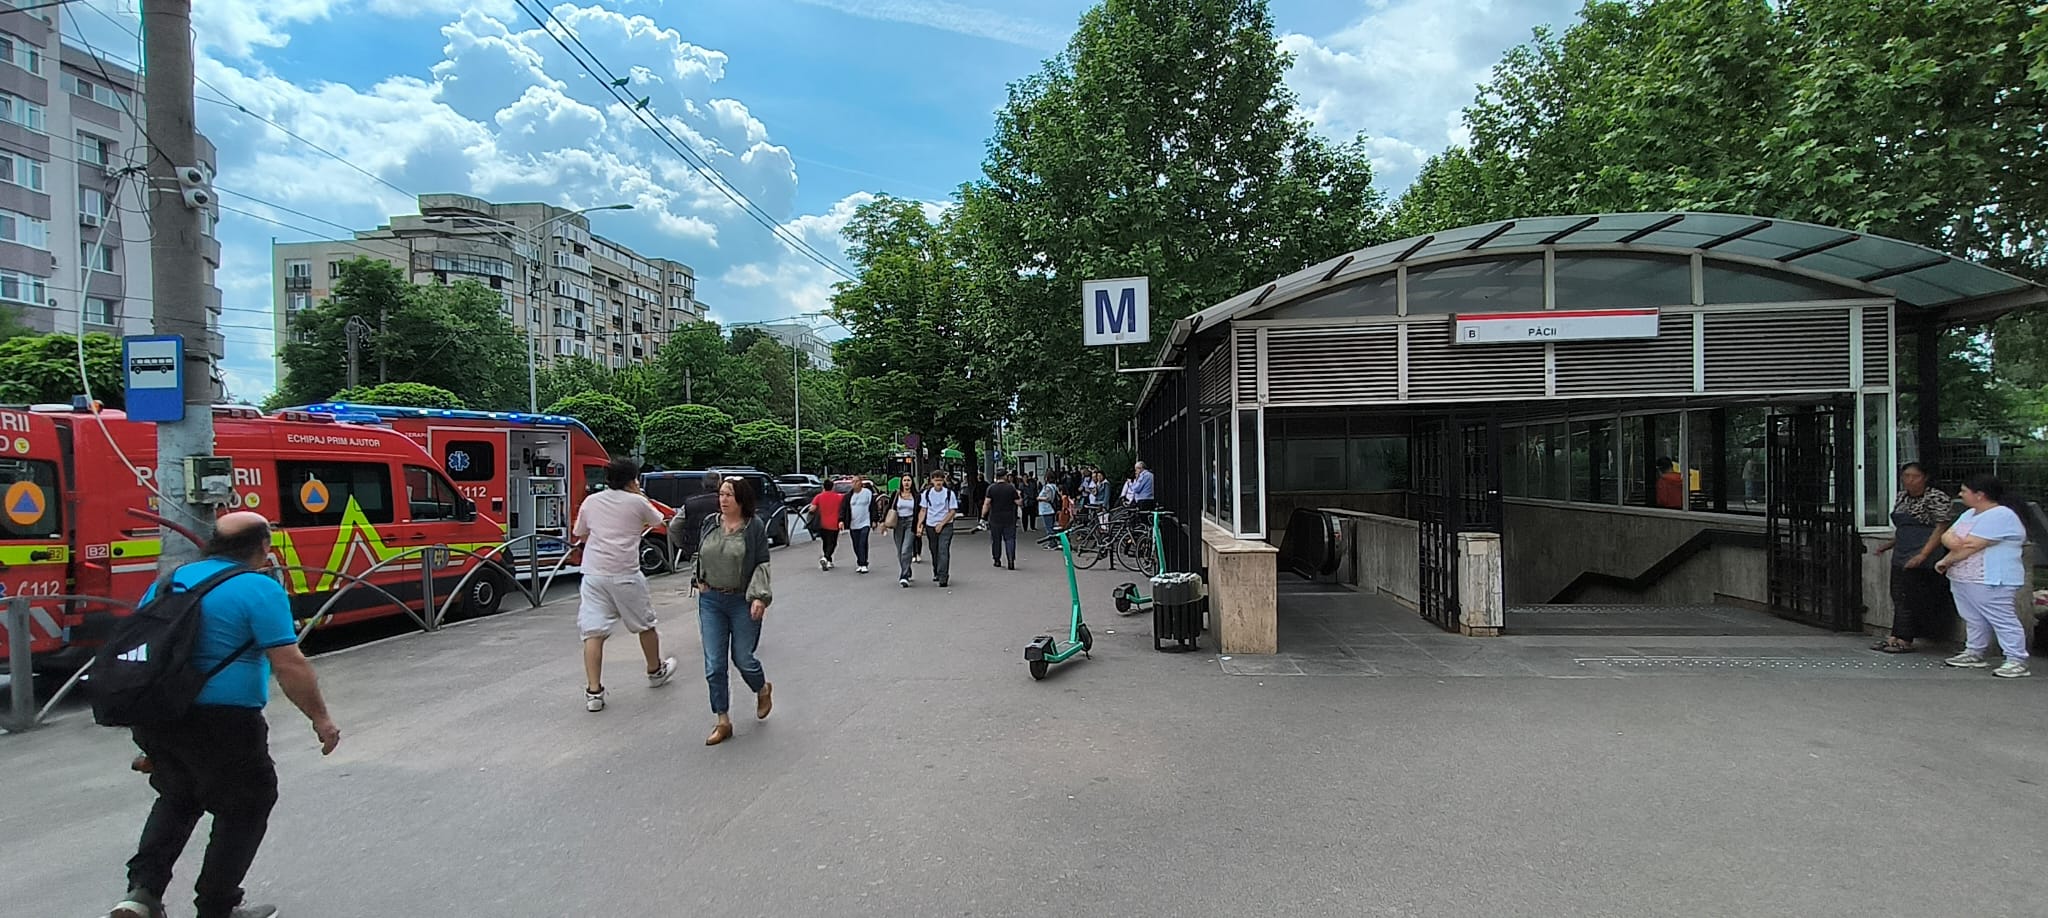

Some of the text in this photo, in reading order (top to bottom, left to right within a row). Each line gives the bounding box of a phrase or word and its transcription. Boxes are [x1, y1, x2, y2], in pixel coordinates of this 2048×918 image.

[1095, 288, 1136, 334] M
[1468, 329, 1476, 338] B
[0, 411, 30, 433] RII
[287, 433, 381, 448] ECHIPAJ PRIM AJUTOR
[463, 486, 487, 497] 112
[88, 546, 106, 557] B2
[31, 580, 60, 597] 112
